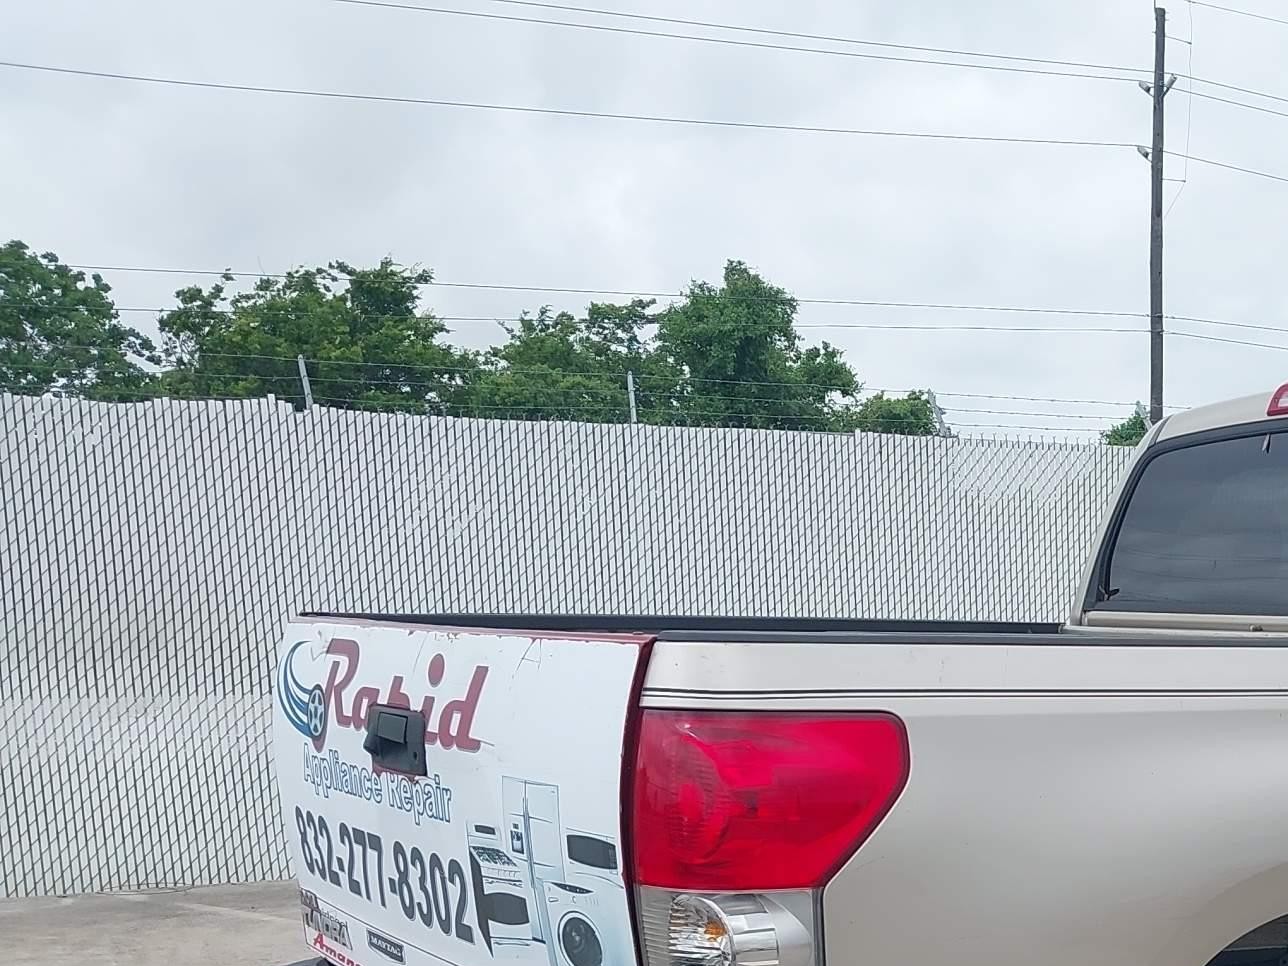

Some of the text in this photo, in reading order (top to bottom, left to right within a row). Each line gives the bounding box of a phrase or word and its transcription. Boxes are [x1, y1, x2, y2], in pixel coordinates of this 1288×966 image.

[304, 743, 451, 825] Appliance Repair
[295, 805, 475, 945] 832-277-8302
[370, 934, 402, 957] MAYTAG
